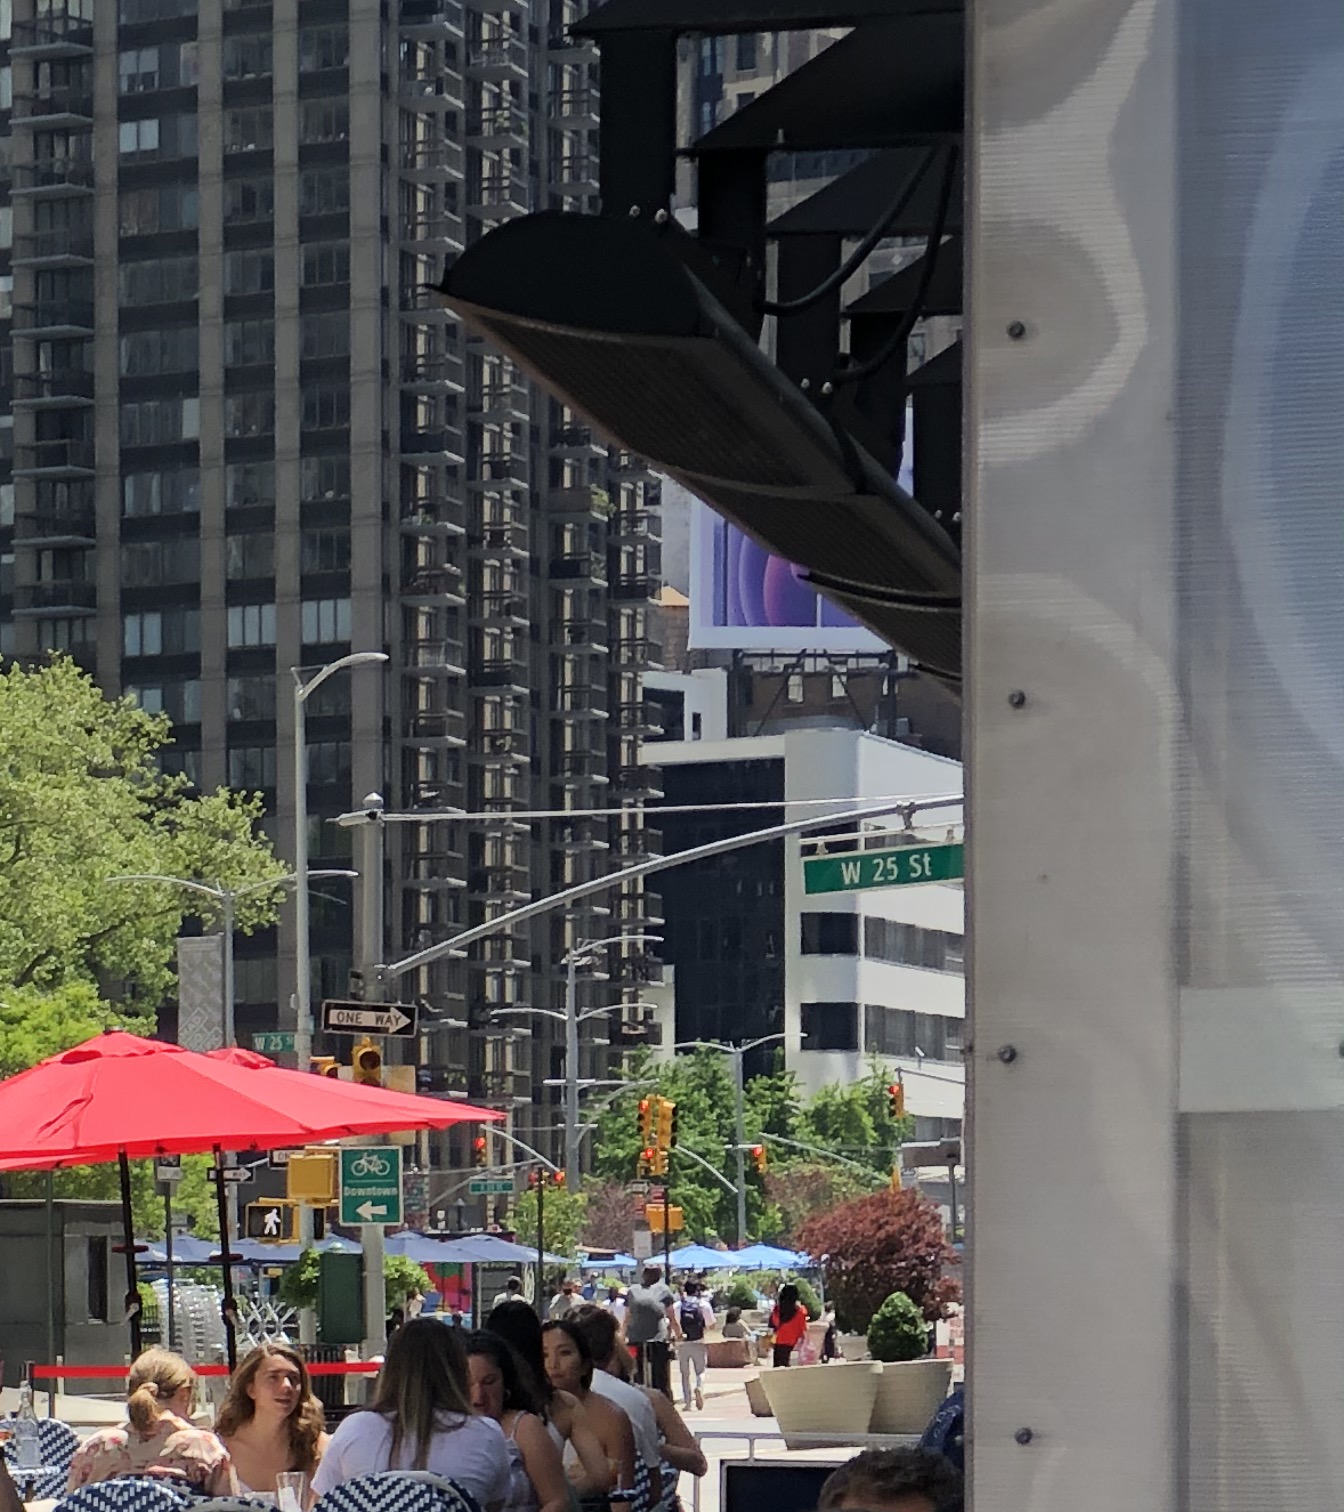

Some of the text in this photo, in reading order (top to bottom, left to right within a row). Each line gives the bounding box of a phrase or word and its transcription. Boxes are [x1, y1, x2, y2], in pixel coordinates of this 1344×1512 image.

[841, 852, 932, 885] W 25 St
[336, 1011, 402, 1026] ONE WAY
[254, 1037, 266, 1050] W
[343, 1186, 398, 1197] Downtown
